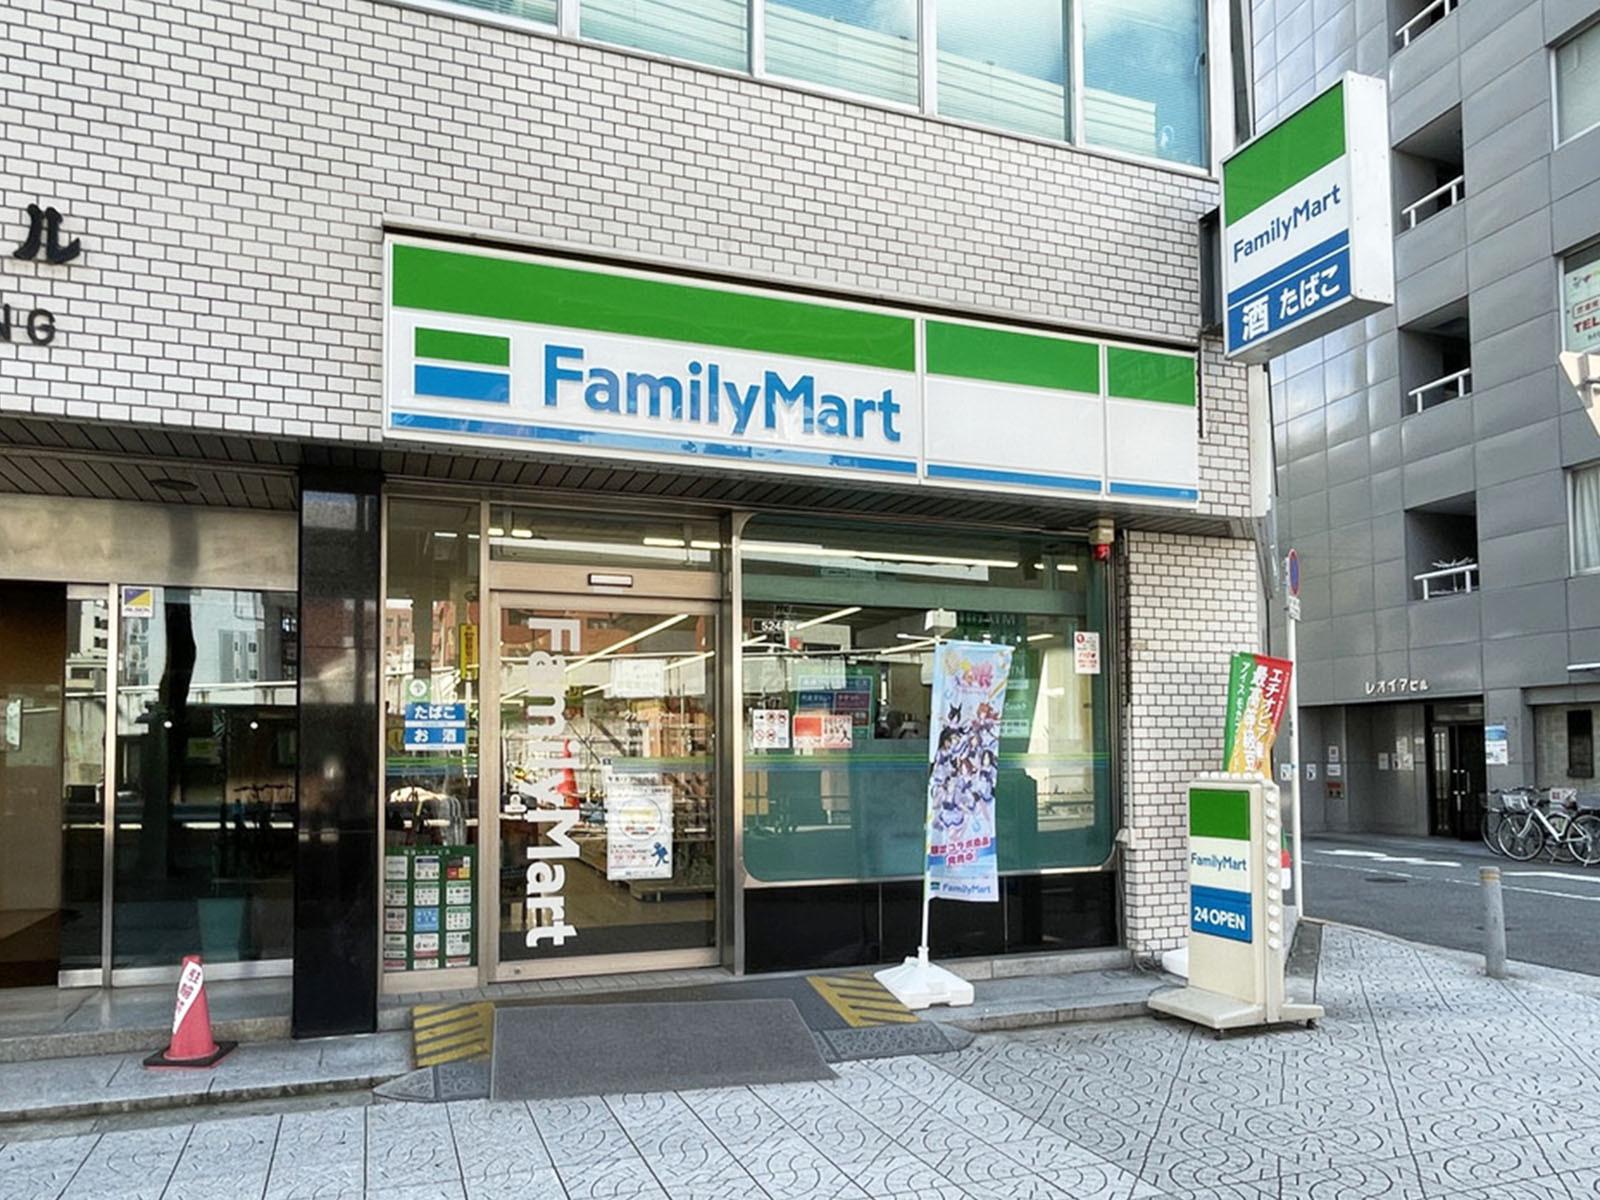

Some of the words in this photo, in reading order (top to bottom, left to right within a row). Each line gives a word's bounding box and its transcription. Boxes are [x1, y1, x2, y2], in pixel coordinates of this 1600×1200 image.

[14, 203, 81, 265] ル
[1233, 183, 1341, 263] FamilyMart
[1242, 296, 1269, 341] 酒
[1280, 264, 1341, 319] たばこ
[544, 343, 902, 442] FamilyMart
[414, 705, 456, 720] たばこ
[519, 617, 581, 949] FamilyMart
[943, 882, 991, 894] FamilyMart
[1190, 852, 1248, 872] FamilyMart
